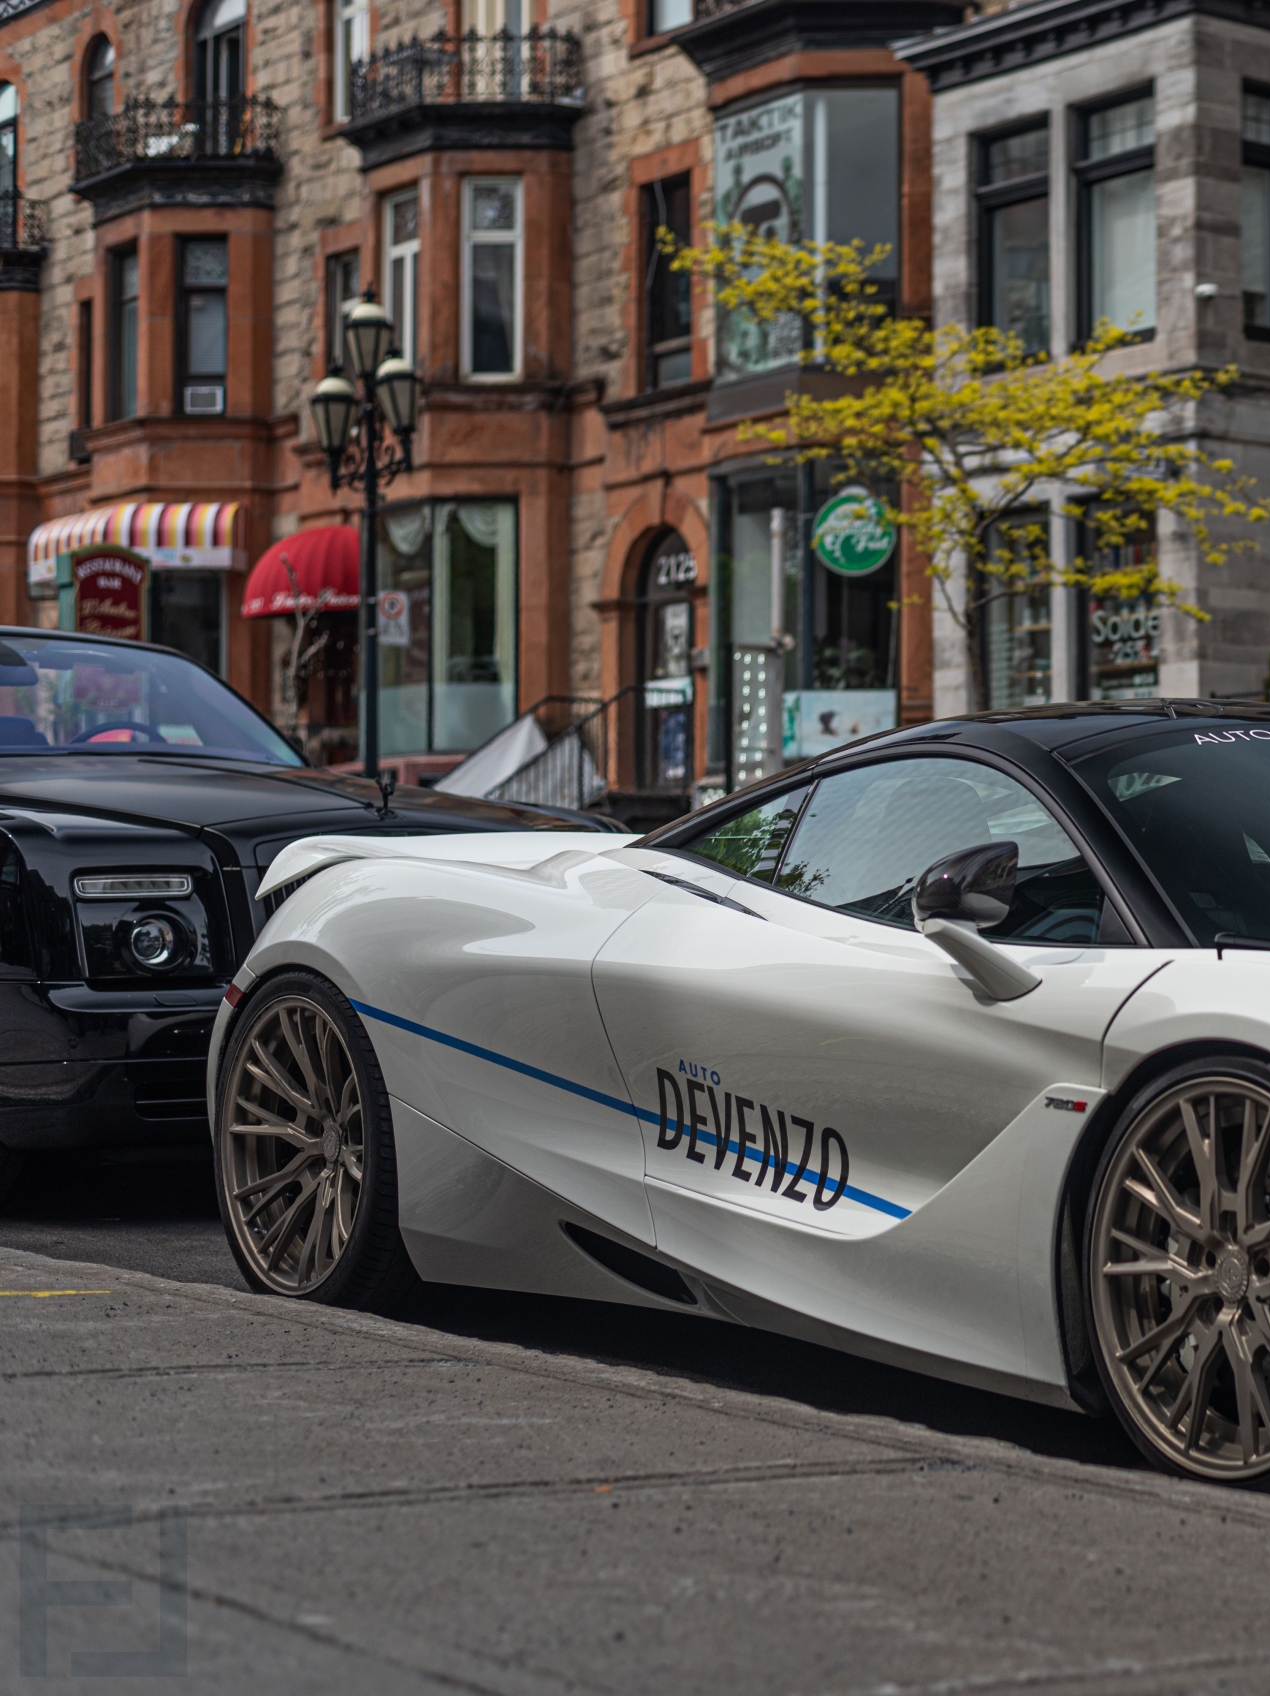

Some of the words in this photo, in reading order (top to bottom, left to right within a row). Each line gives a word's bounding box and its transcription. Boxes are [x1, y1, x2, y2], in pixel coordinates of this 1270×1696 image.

[1092, 607, 1160, 643] Solde
[678, 1058, 721, 1086] AUTO
[656, 1066, 850, 1211] DEVENZO
